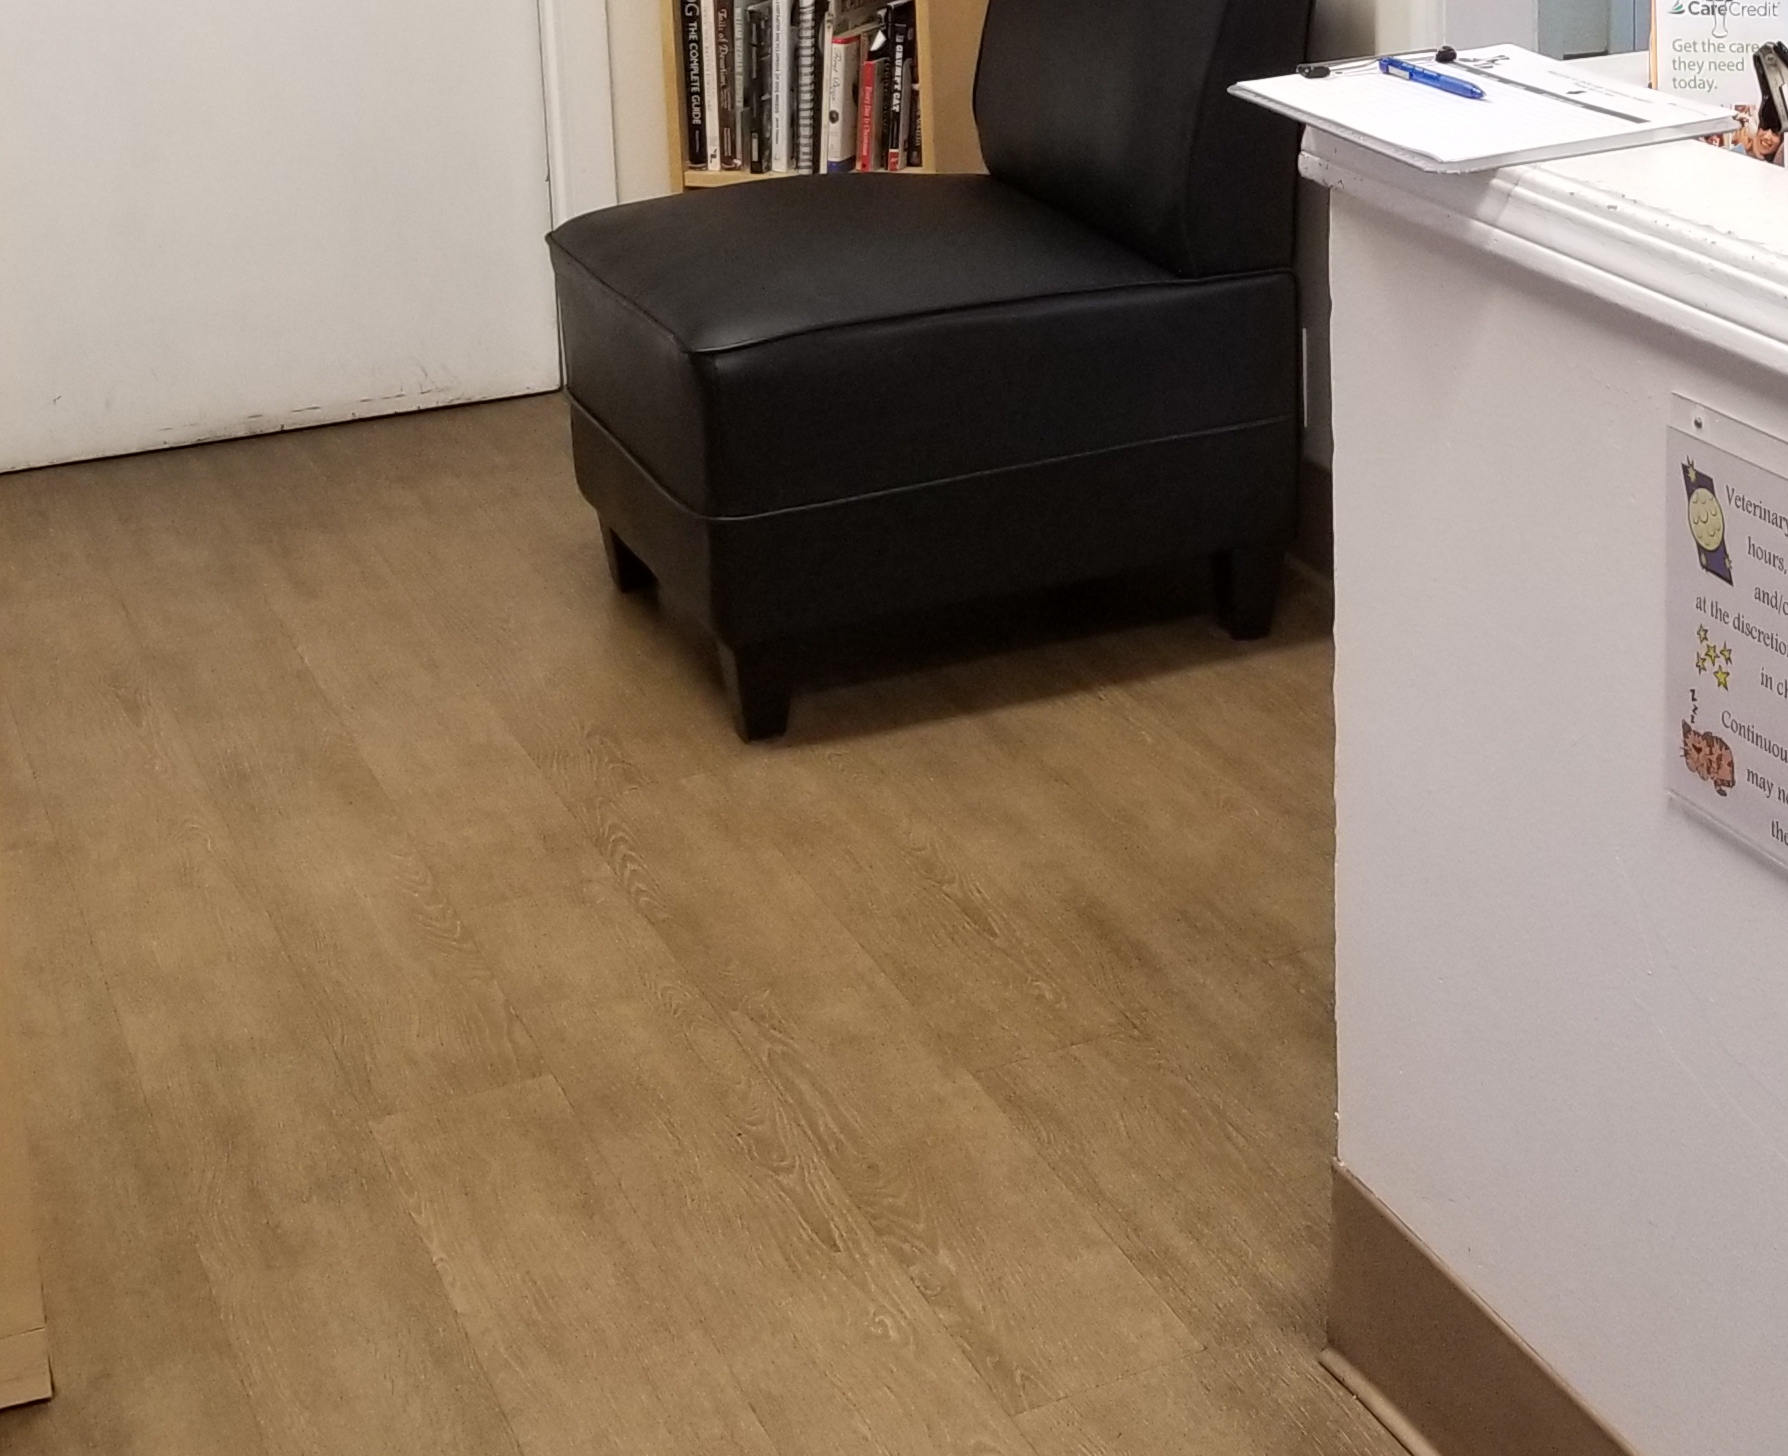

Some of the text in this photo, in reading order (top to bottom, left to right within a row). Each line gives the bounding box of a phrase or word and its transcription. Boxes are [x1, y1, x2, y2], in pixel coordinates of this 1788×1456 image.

[688, 21, 699, 41] THE
[1672, 38, 1759, 53] Get the care
[688, 42, 701, 93] COMPLETE
[892, 44, 904, 113] GRUMPY CAT
[1672, 56, 1745, 75] they need
[1672, 74, 1718, 93] today.
[691, 94, 702, 126] GUIDE
[1747, 536, 1788, 574] hours,
[1695, 596, 1708, 614] at
[1709, 601, 1730, 626] the
[1760, 667, 1773, 689] in
[1746, 767, 1774, 799] may
